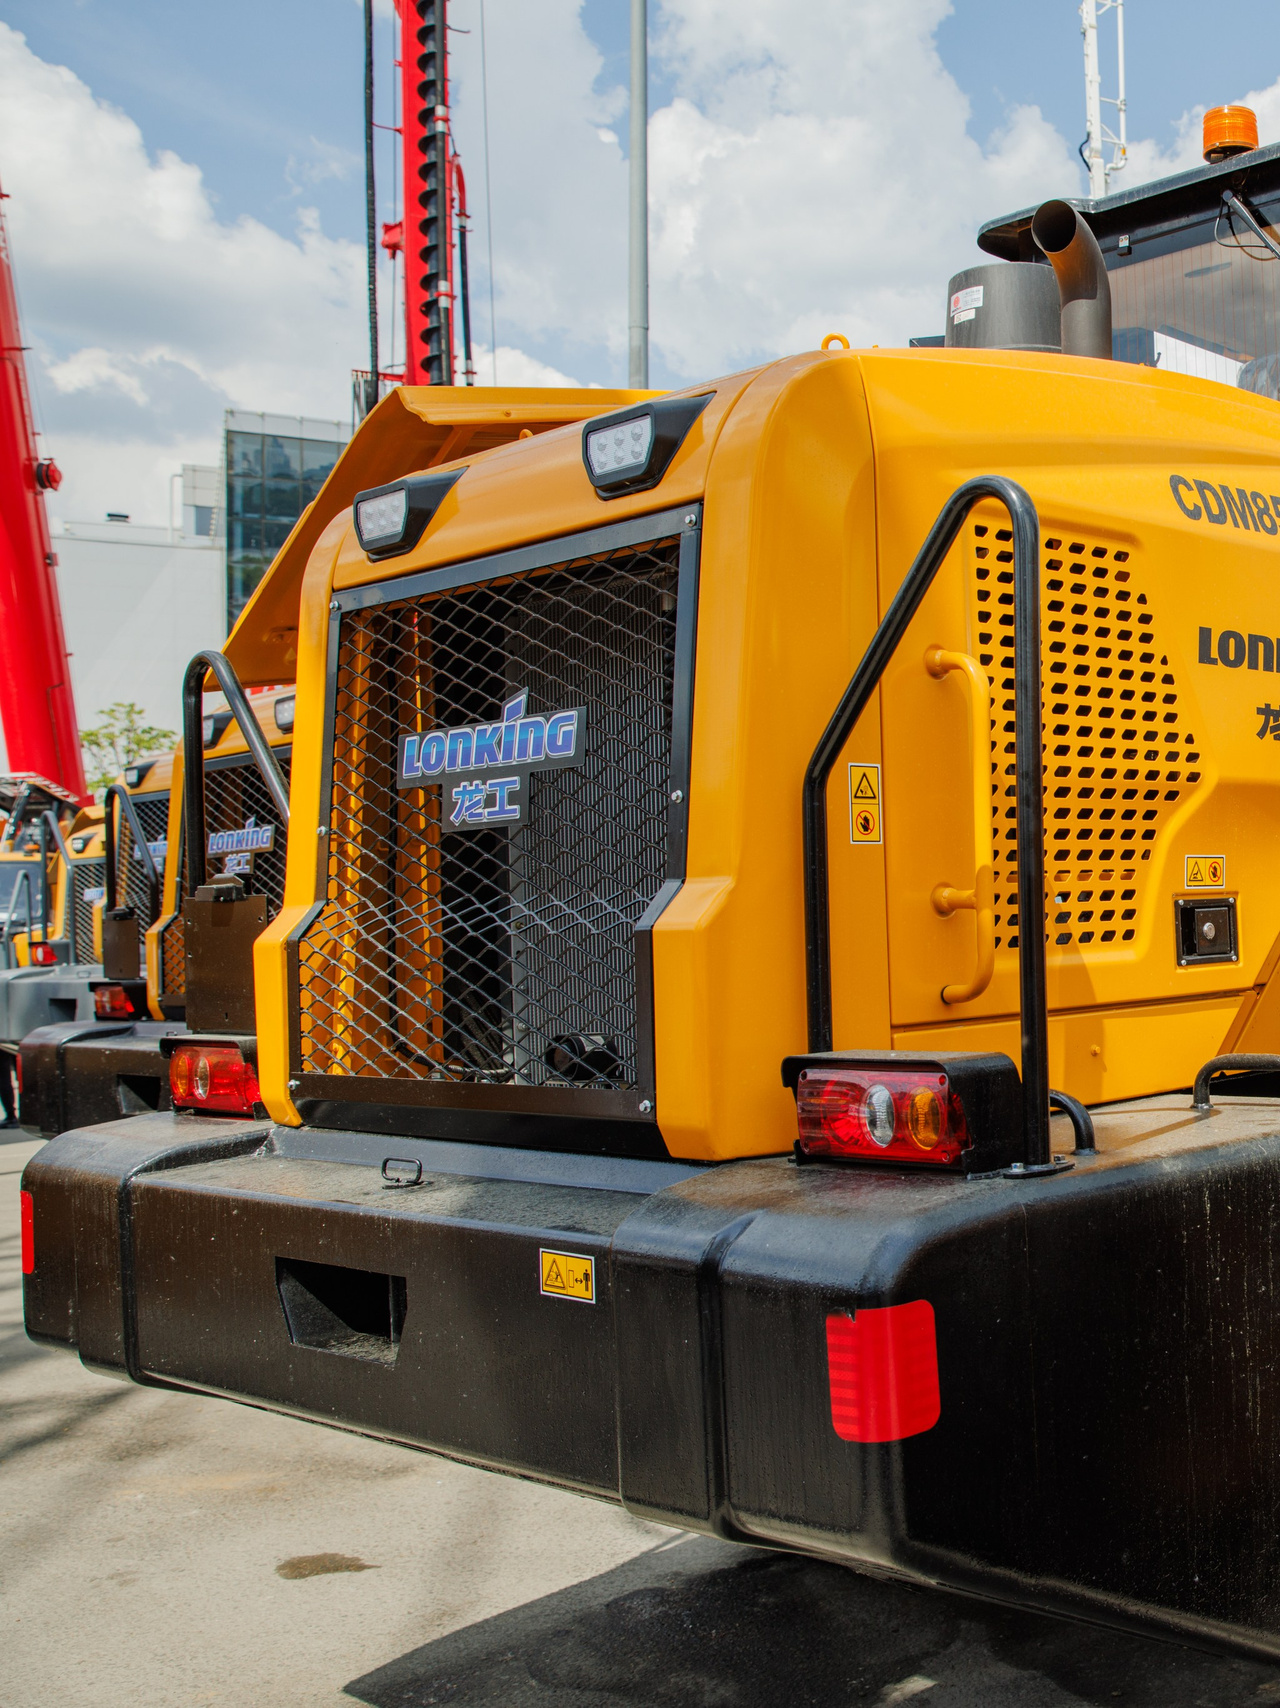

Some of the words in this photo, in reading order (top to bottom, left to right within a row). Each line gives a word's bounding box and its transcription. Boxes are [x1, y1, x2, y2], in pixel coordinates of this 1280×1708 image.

[402, 694, 579, 779] LONKING
[450, 776, 520, 826] 龙工
[207, 817, 273, 853] LONKING
